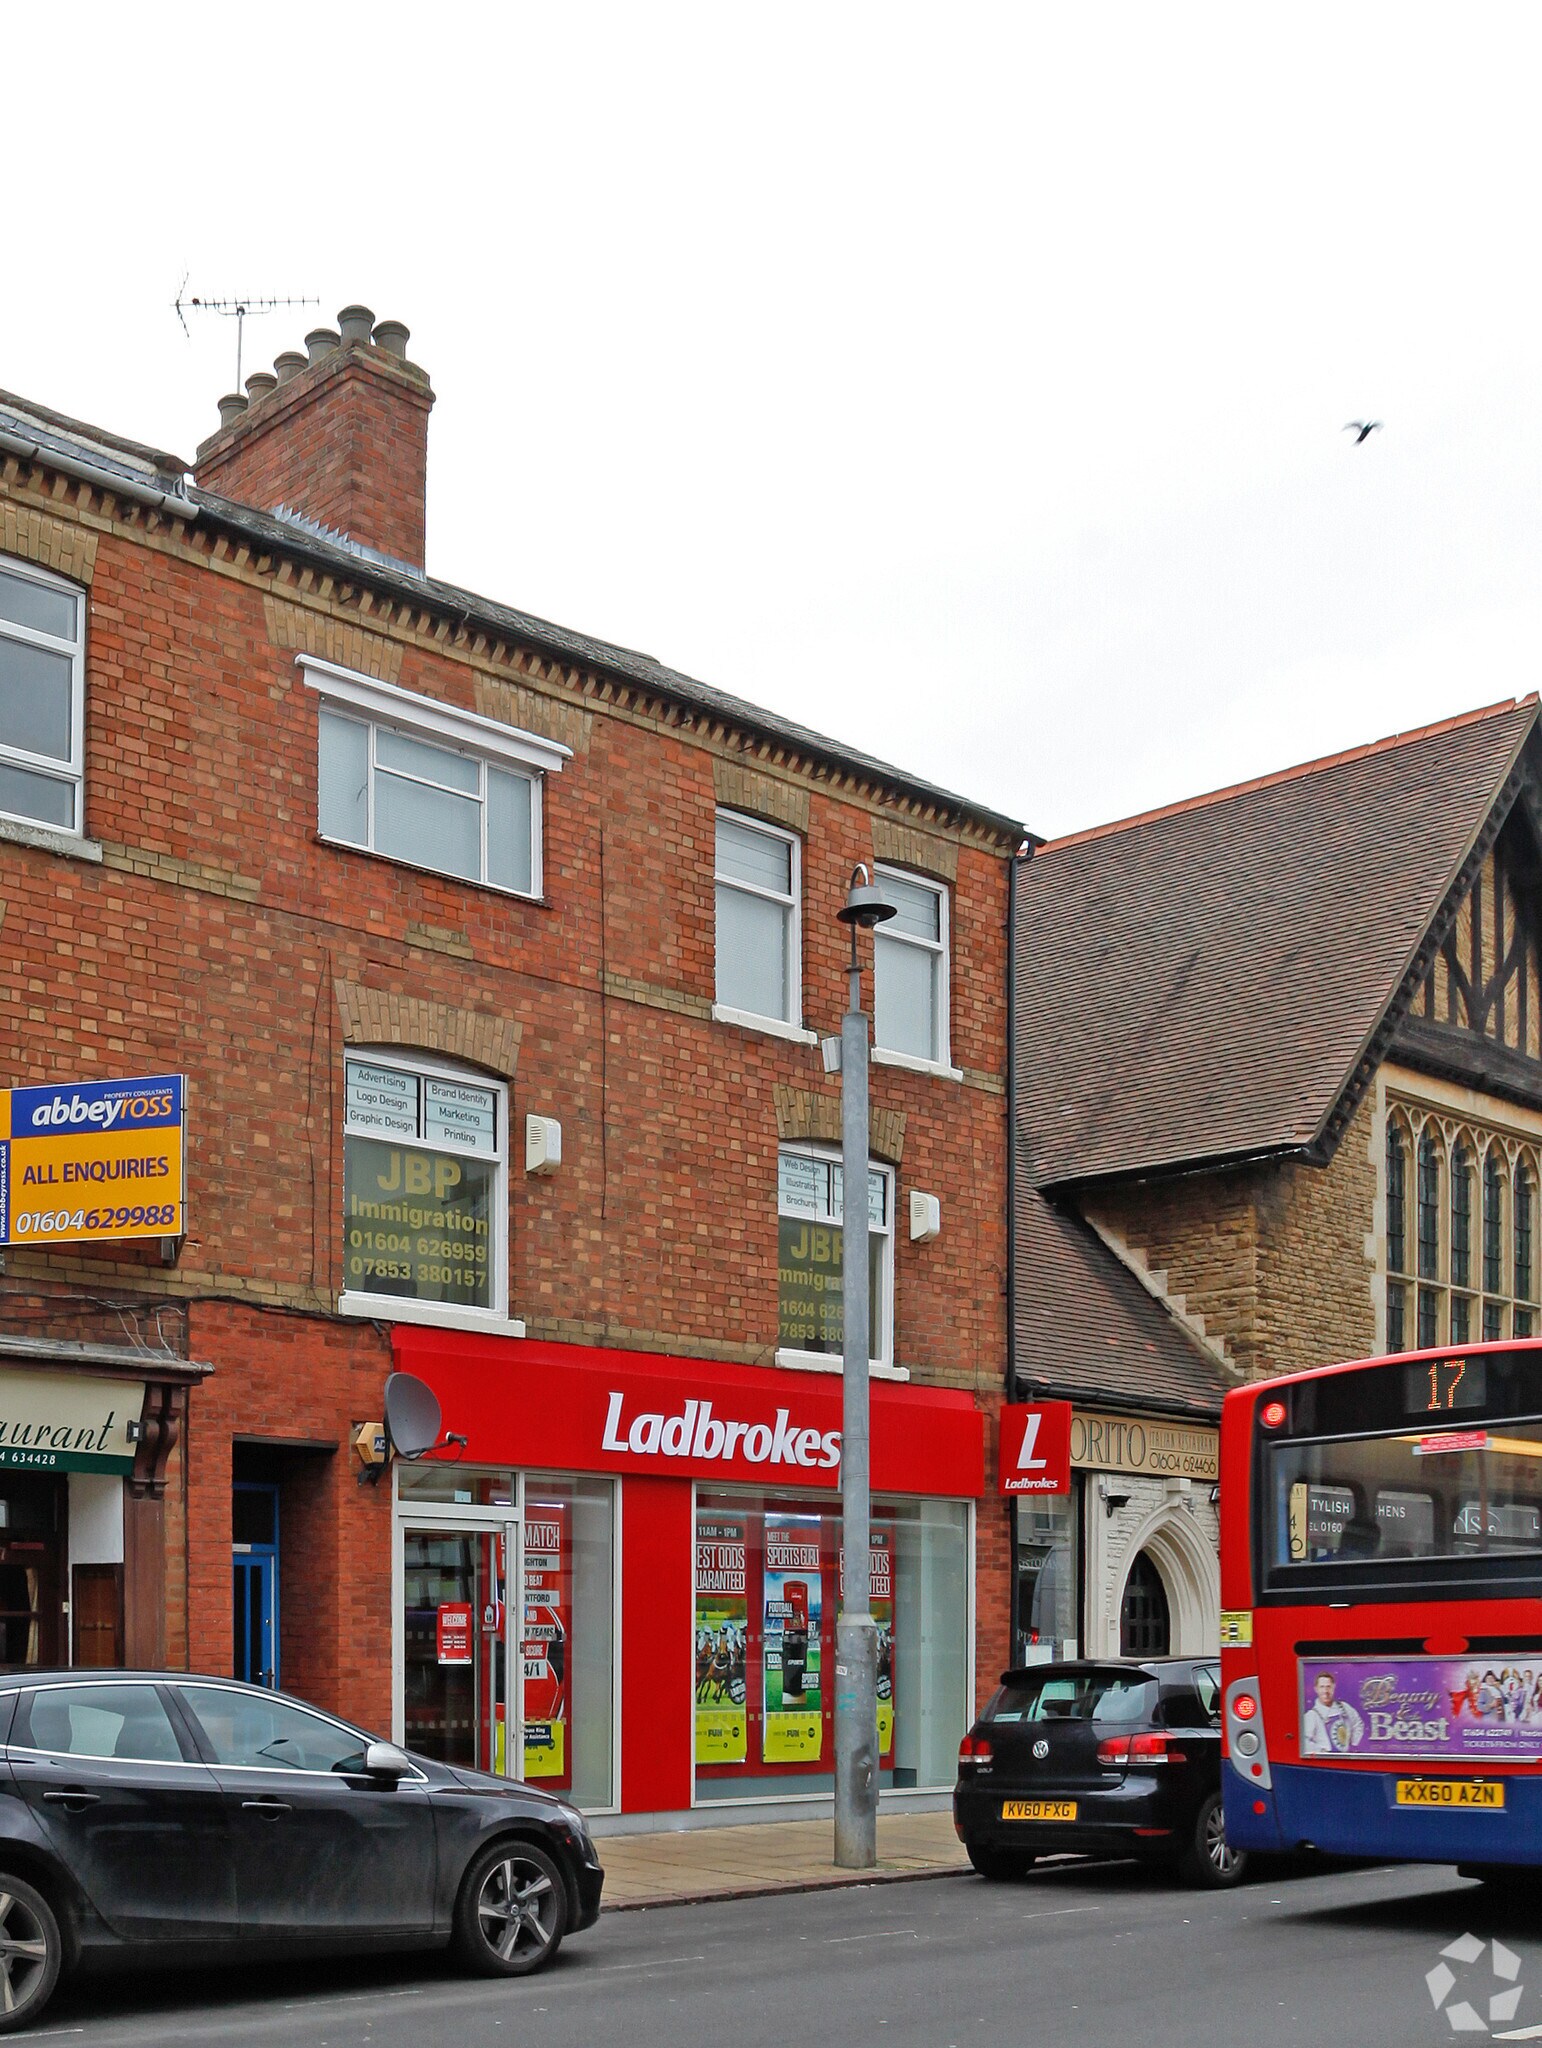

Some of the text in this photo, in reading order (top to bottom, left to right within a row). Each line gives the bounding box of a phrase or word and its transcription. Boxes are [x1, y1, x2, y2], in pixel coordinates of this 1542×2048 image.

[358, 1069, 406, 1091] Advertising
[104, 1088, 173, 1100] PROPERTY CONSULTANTS
[356, 1089, 408, 1111] Logo Design
[431, 1084, 488, 1107] Brand Identity
[32, 1094, 173, 1129] abbeyross
[350, 1109, 413, 1132] Graphic Design
[439, 1106, 480, 1126] Marketing
[444, 1128, 476, 1145] Printing
[22, 1156, 169, 1186] ALL ENQUIRIES
[376, 1151, 462, 1198] JBP
[784, 1158, 821, 1175] Web Design
[785, 1177, 819, 1191] Illustration
[786, 1194, 818, 1209] Brochures
[16, 1203, 175, 1234] 01604629988
[351, 1194, 489, 1236] Immigration
[350, 1229, 488, 1264] 01604 626959
[350, 1256, 487, 1288] 07853 380157
[778, 1299, 816, 1318] 1604
[778, 1321, 816, 1340] 7853
[1427, 1358, 1466, 1411] 17
[601, 1390, 843, 1469] Ladbrokes
[1016, 1413, 1048, 1470] L
[11, 1451, 57, 1466] 634428
[1149, 1452, 1180, 1470] 01604
[1004, 1477, 1059, 1490] Ladbrokes
[524, 1525, 560, 1548] MATCH
[698, 1526, 717, 1537] 11AM
[724, 1527, 737, 1538] 1PM
[767, 1531, 790, 1542] MEET THE
[718, 1546, 745, 1570] ODDS
[767, 1546, 800, 1565] SPORTS
[800, 1547, 819, 1566] GURU
[529, 1575, 543, 1587] BEAT
[768, 1601, 793, 1613] FOOTBALL
[532, 1626, 554, 1637] TEAMS
[525, 1644, 544, 1656] SCORE
[1360, 1673, 1440, 1711] Beauty
[1367, 1712, 1451, 1741] Beast
[1404, 1785, 1495, 1804] KX60 AZN
[1007, 1802, 1070, 1818] KV60 FXG
